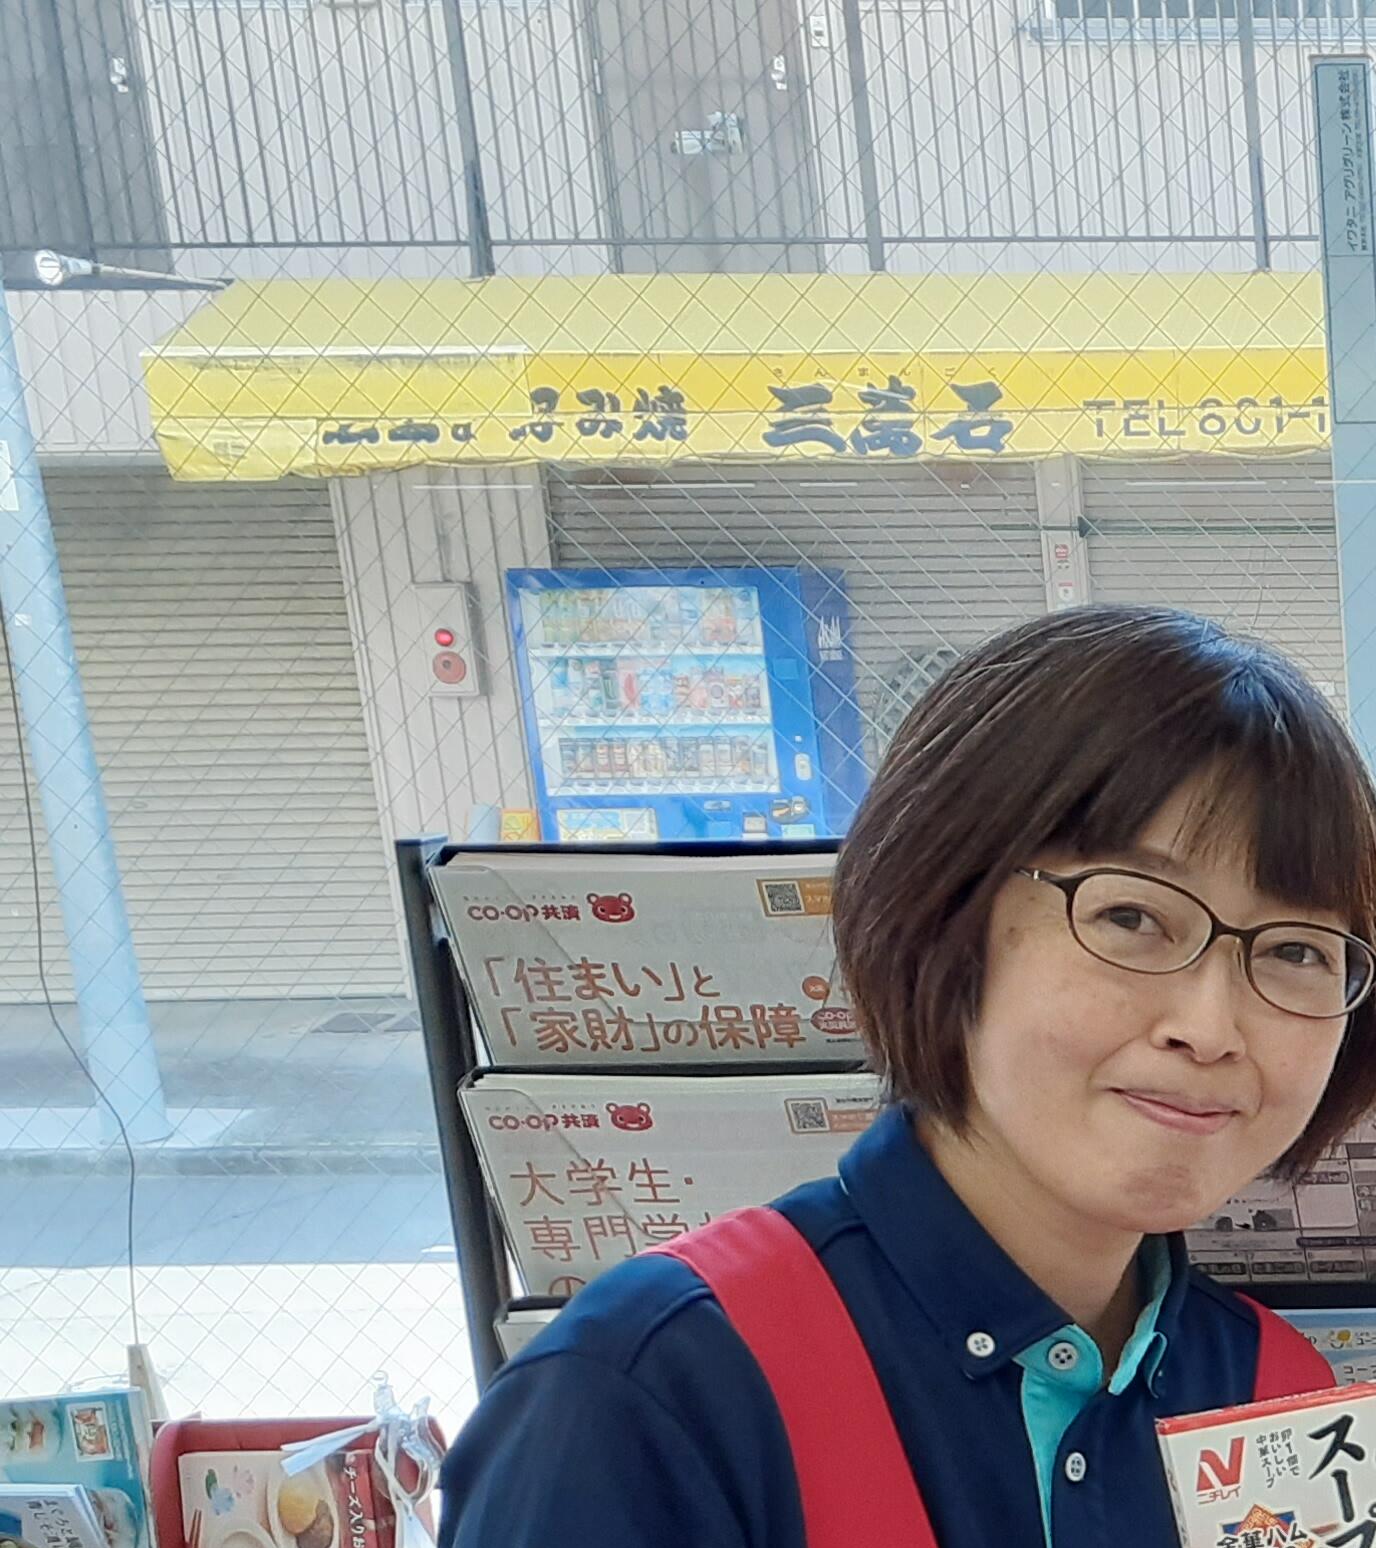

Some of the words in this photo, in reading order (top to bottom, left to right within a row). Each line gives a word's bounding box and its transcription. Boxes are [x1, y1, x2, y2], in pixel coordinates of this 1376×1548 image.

[484, 956, 721, 1003] 「住まい」と
[500, 1001, 807, 1054] 「家財」の保障
